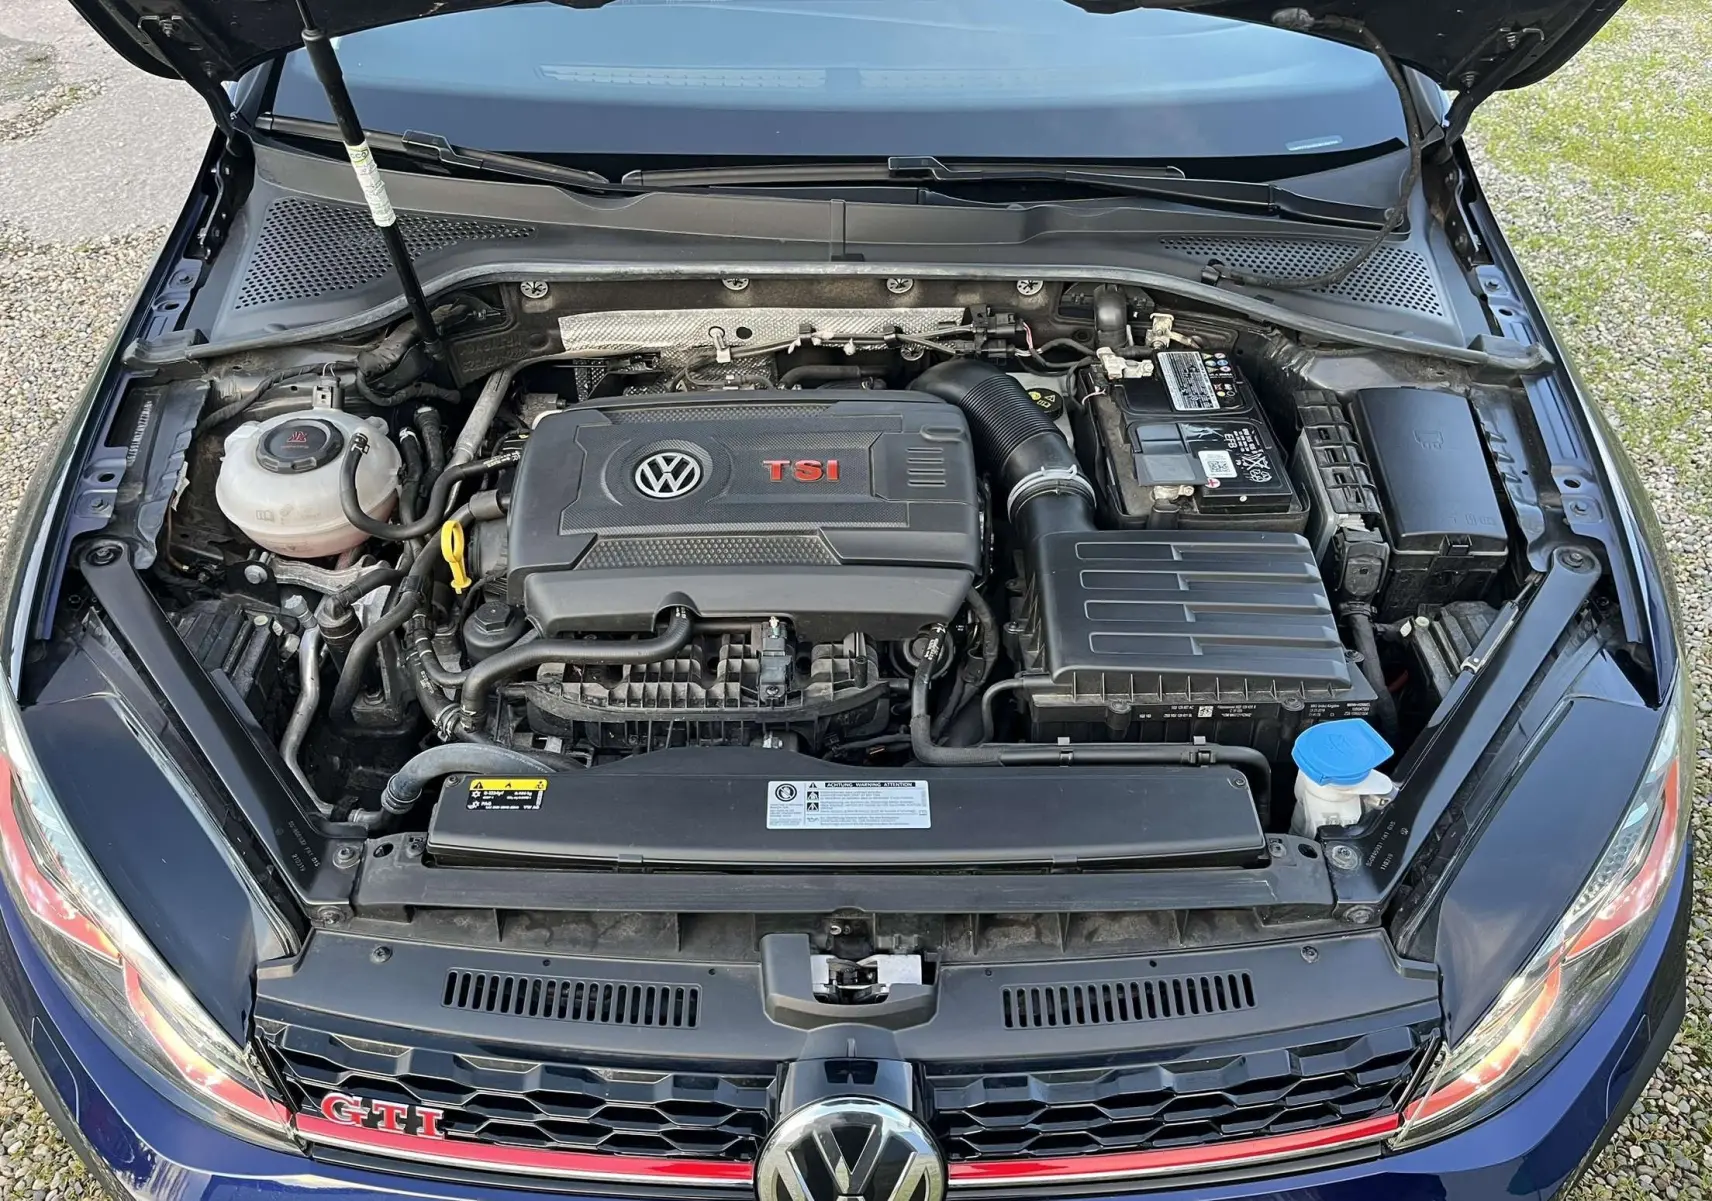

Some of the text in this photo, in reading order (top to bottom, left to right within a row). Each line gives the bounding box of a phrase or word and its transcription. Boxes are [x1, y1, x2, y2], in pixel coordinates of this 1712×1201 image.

[635, 452, 701, 498] VW
[763, 459, 840, 482] TSI
[320, 1092, 445, 1140] GTI
